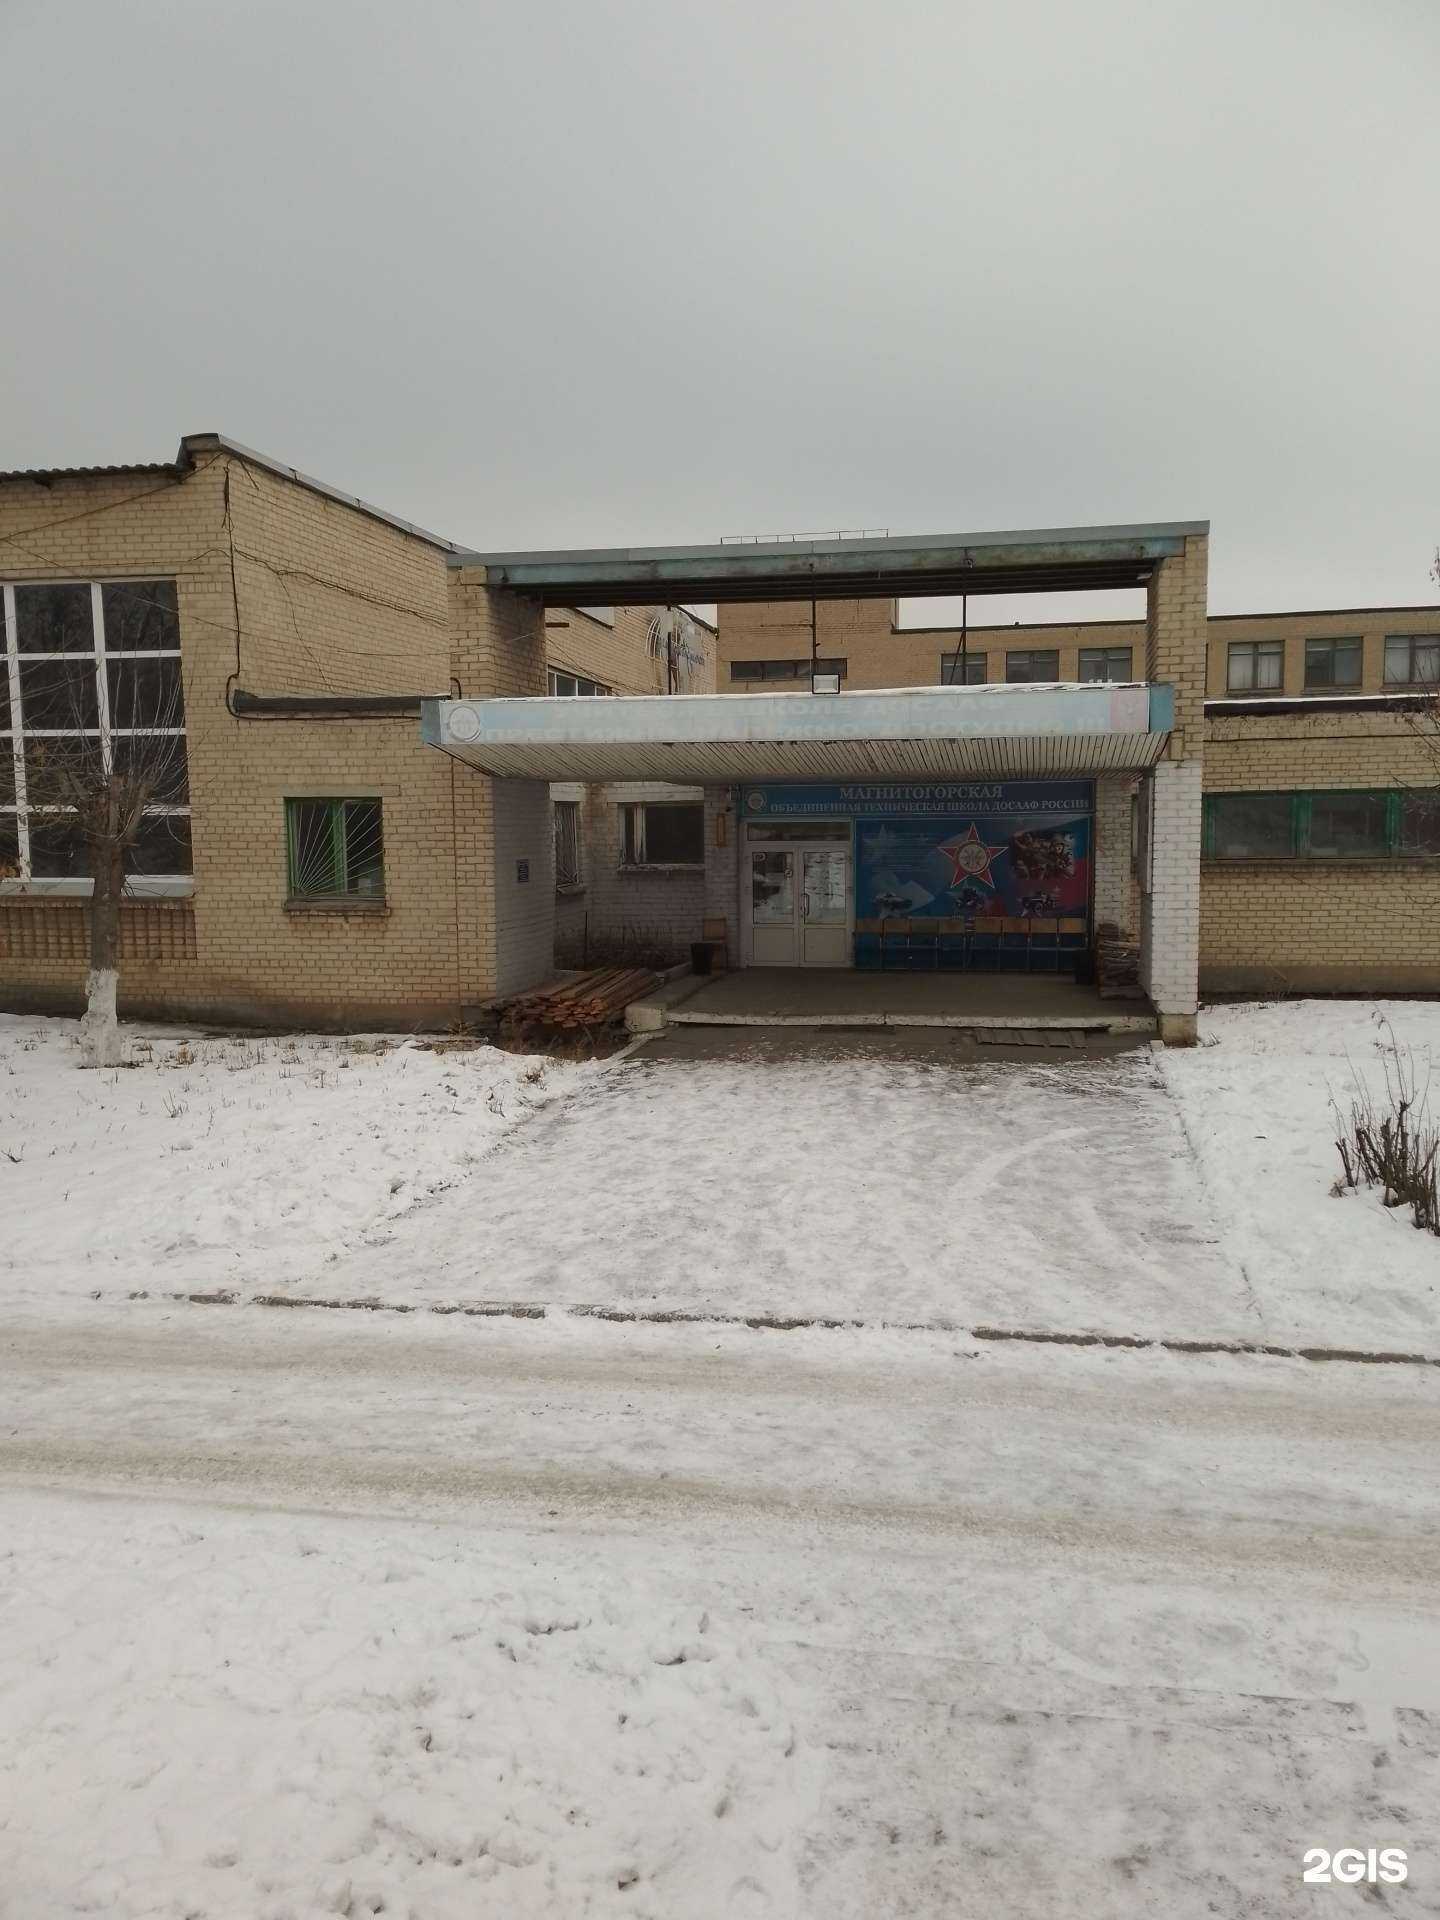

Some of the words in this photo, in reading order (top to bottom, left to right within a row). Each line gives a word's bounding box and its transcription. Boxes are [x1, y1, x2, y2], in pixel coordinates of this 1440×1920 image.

[839, 785, 1004, 800] МАГНИТОГОРСКАЯ
[864, 801, 945, 813] ТЕХНИЧЕСКАЯ
[946, 801, 990, 811] ШКОЛА
[992, 800, 1039, 812] ДОСААФ
[1042, 799, 1088, 809] РОССИИ
